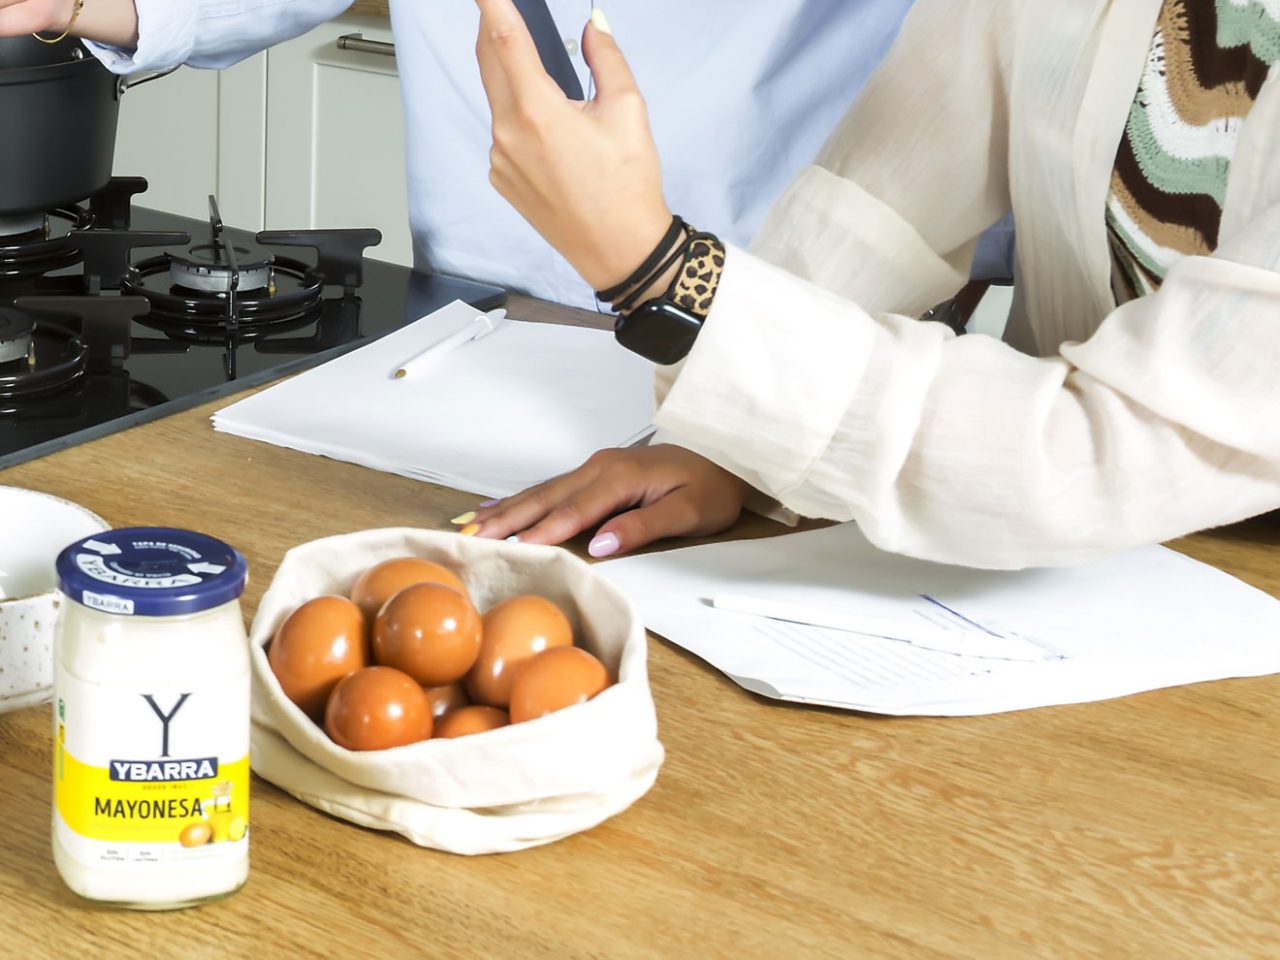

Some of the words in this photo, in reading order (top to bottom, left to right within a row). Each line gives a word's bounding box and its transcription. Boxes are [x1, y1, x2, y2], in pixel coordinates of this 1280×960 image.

[86, 595, 129, 612] YBARRA
[140, 691, 194, 758] Y
[113, 759, 215, 781] YBARRA
[94, 796, 203, 820] MAYONESA
